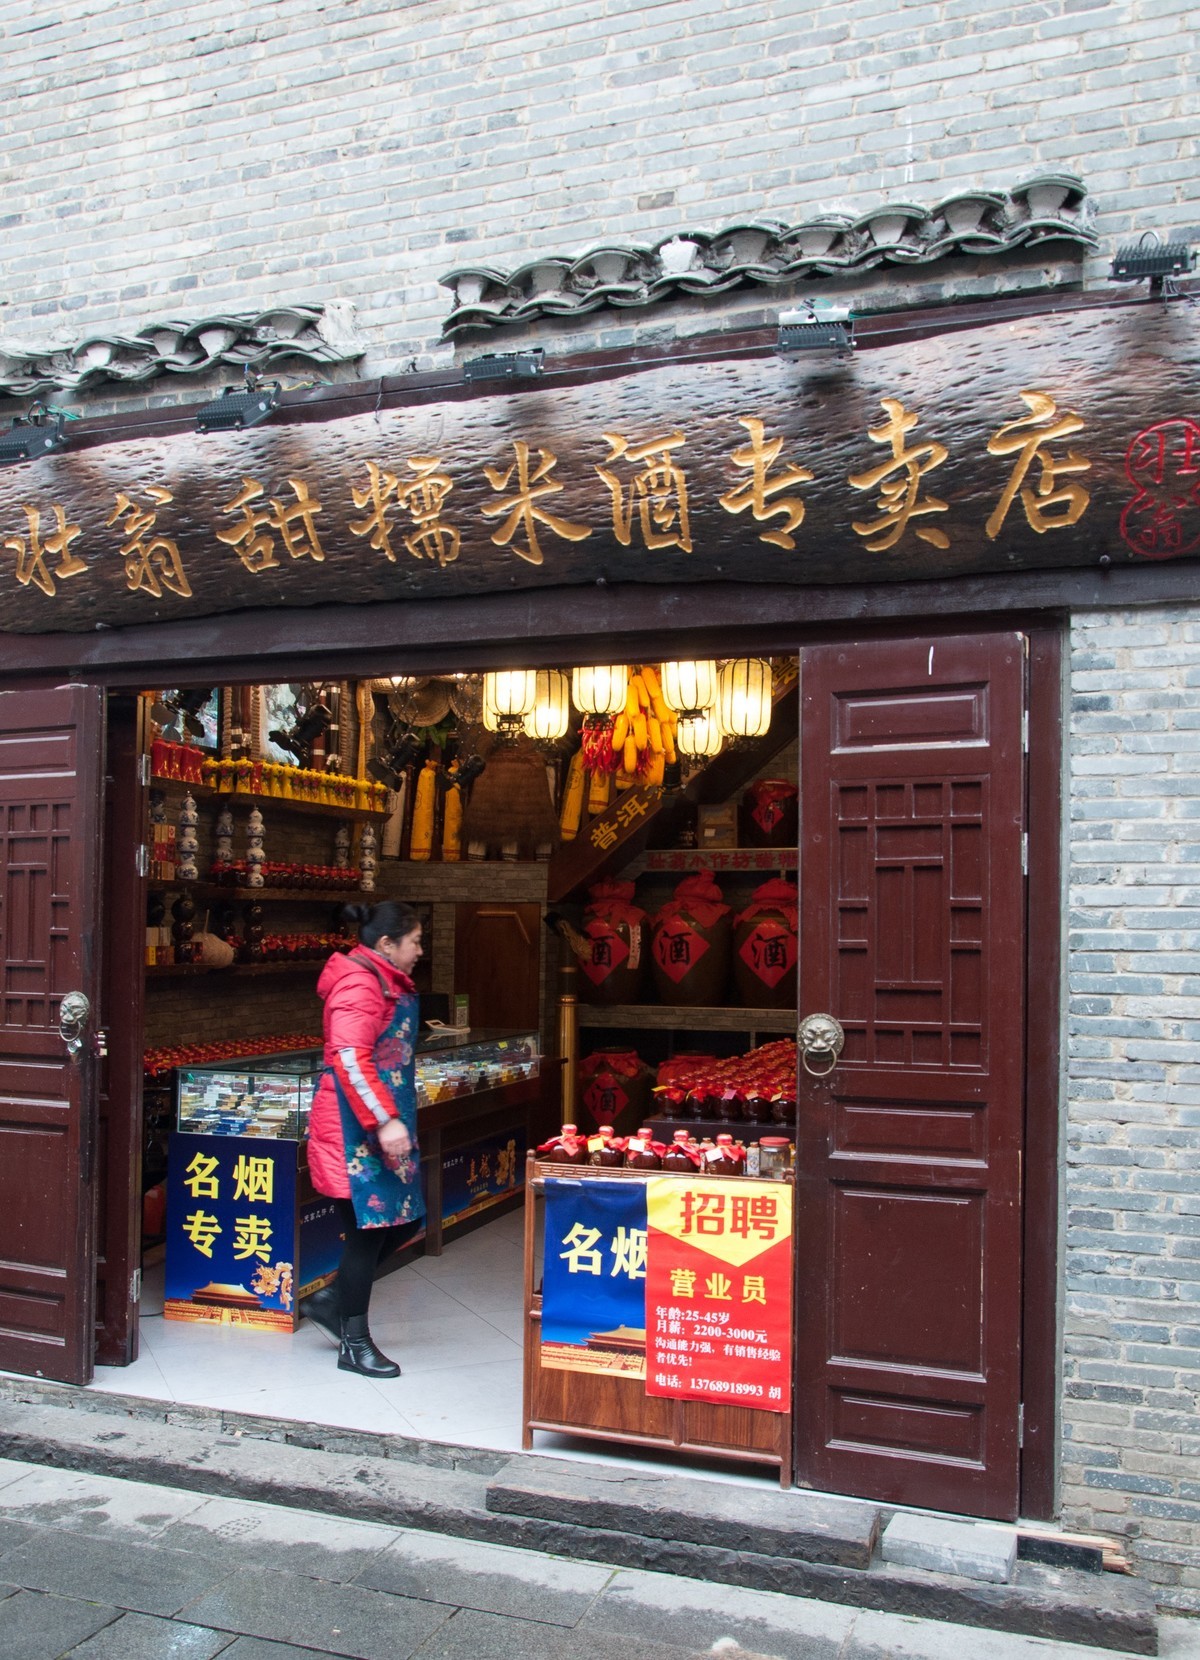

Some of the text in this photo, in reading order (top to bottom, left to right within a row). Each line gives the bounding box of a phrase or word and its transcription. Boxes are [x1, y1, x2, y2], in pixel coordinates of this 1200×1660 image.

[658, 930, 693, 967] 酒
[751, 932, 790, 970] 酒
[591, 1083, 616, 1115] 酒
[183, 1152, 275, 1204] 名烟
[680, 1191, 779, 1240] 招聘
[182, 1209, 274, 1264] 专卖
[670, 1269, 767, 1305] 营业员
[768, 1386, 782, 1400] 胡
